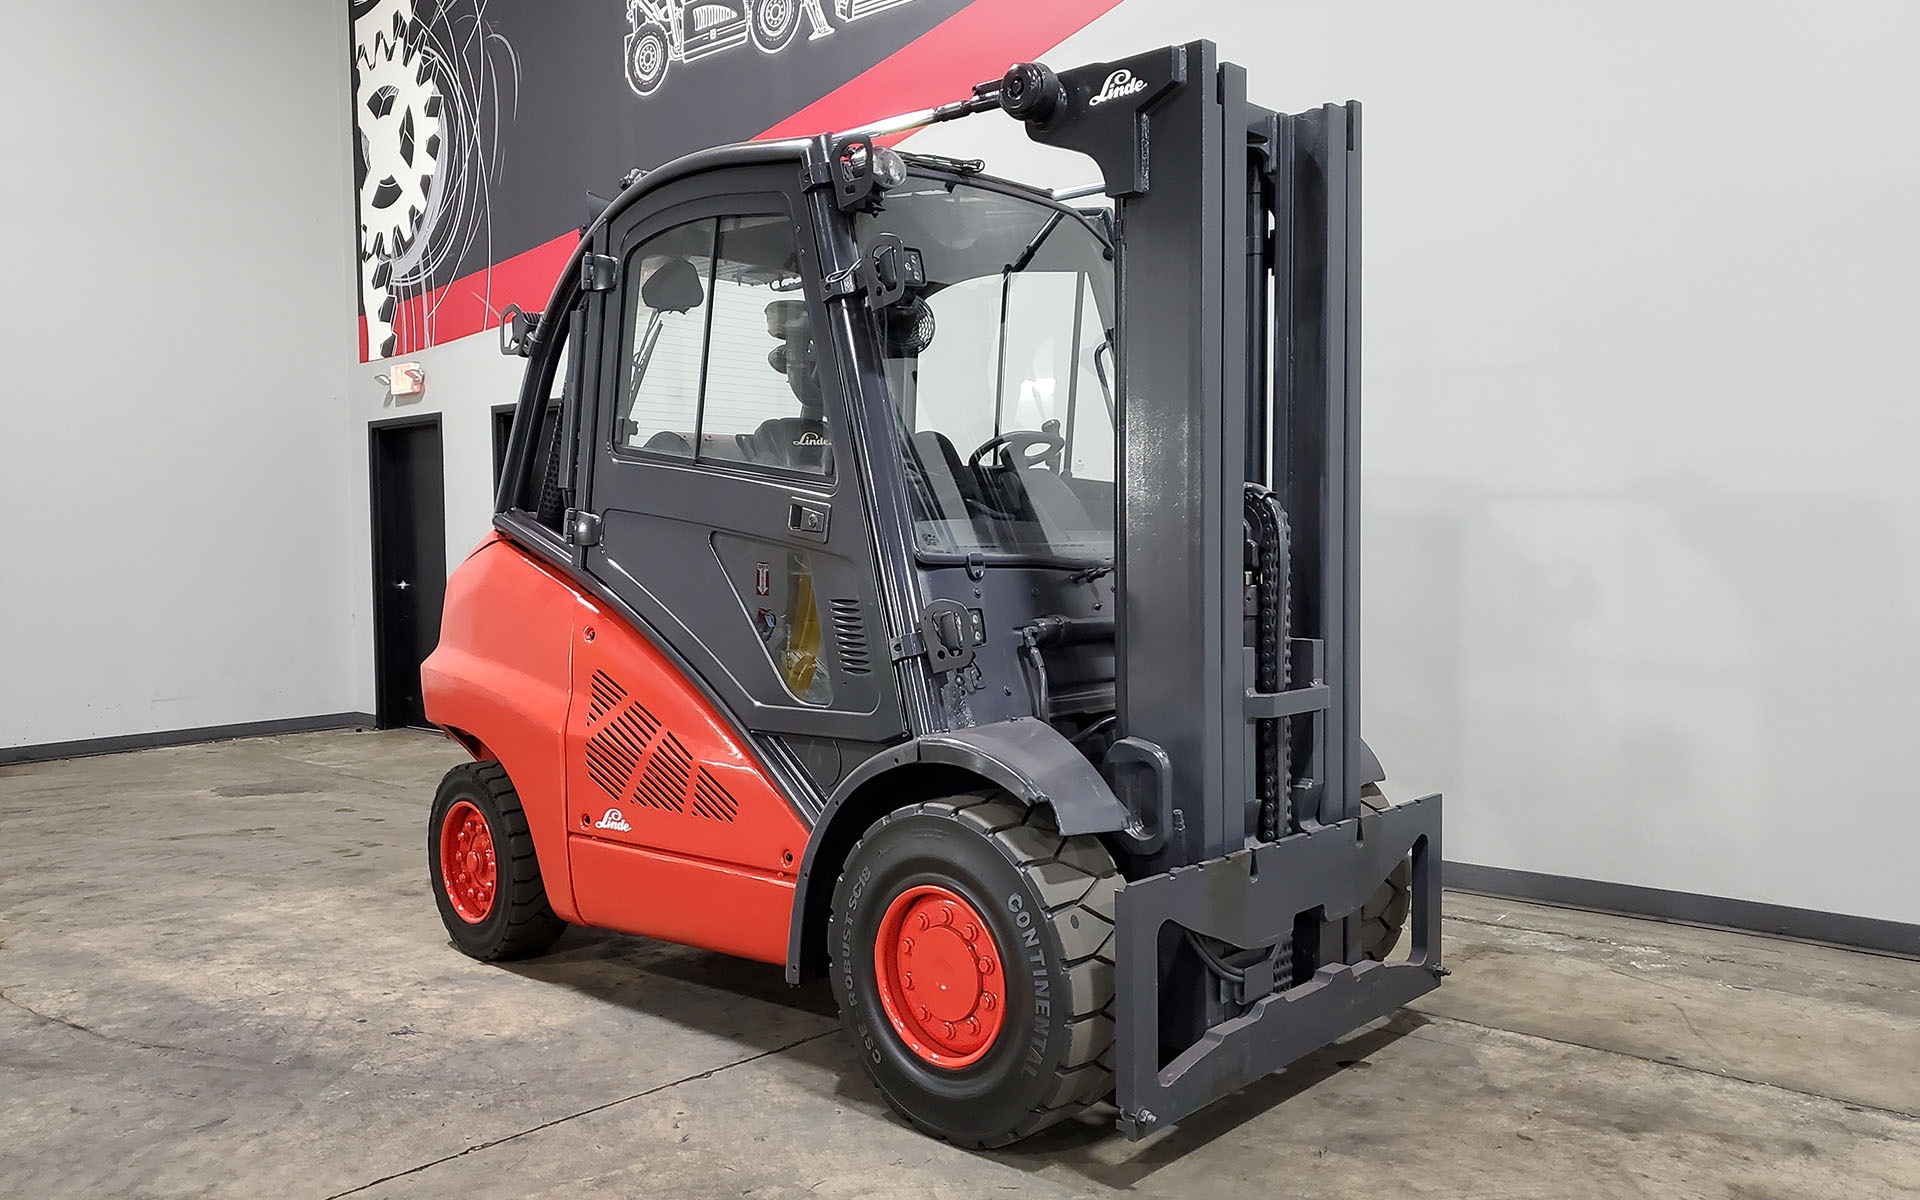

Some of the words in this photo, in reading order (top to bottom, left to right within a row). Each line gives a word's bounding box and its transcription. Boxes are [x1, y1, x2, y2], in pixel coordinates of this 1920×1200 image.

[1089, 69, 1148, 106] Linde
[793, 432, 832, 446] Linde
[595, 808, 632, 832] Linde
[842, 911, 858, 1007] ROBUST
[1007, 892, 1050, 1077] CONTINENTAL
